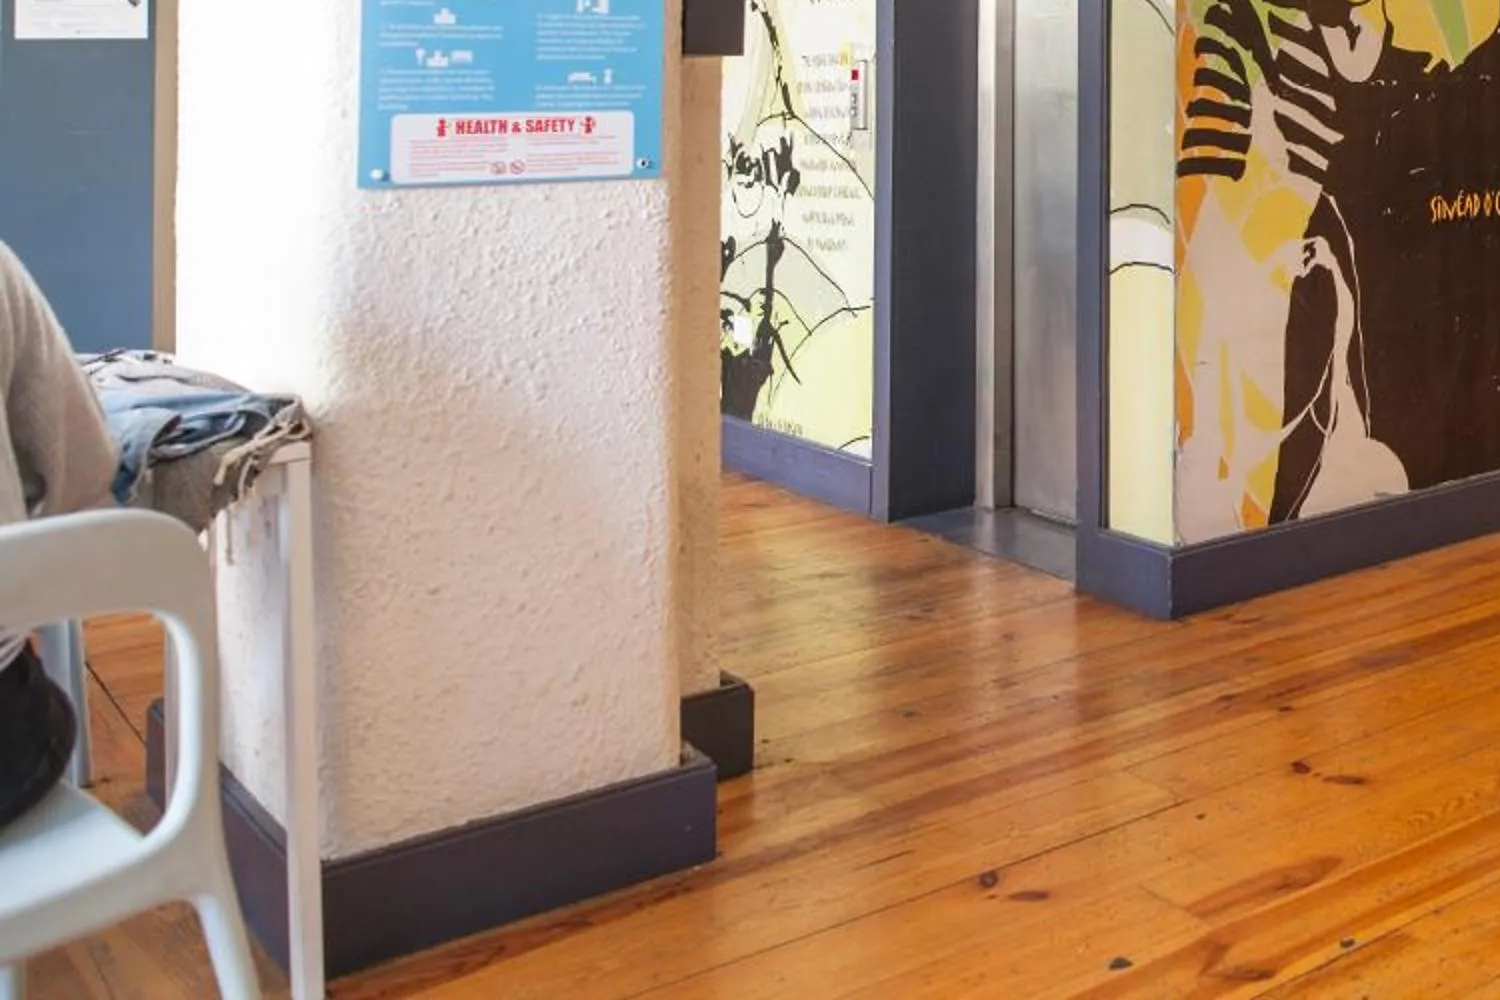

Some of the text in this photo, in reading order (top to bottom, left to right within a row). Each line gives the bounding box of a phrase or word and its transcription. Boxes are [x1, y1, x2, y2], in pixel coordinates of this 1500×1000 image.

[455, 118, 576, 135] HEALTH & SAFETY
